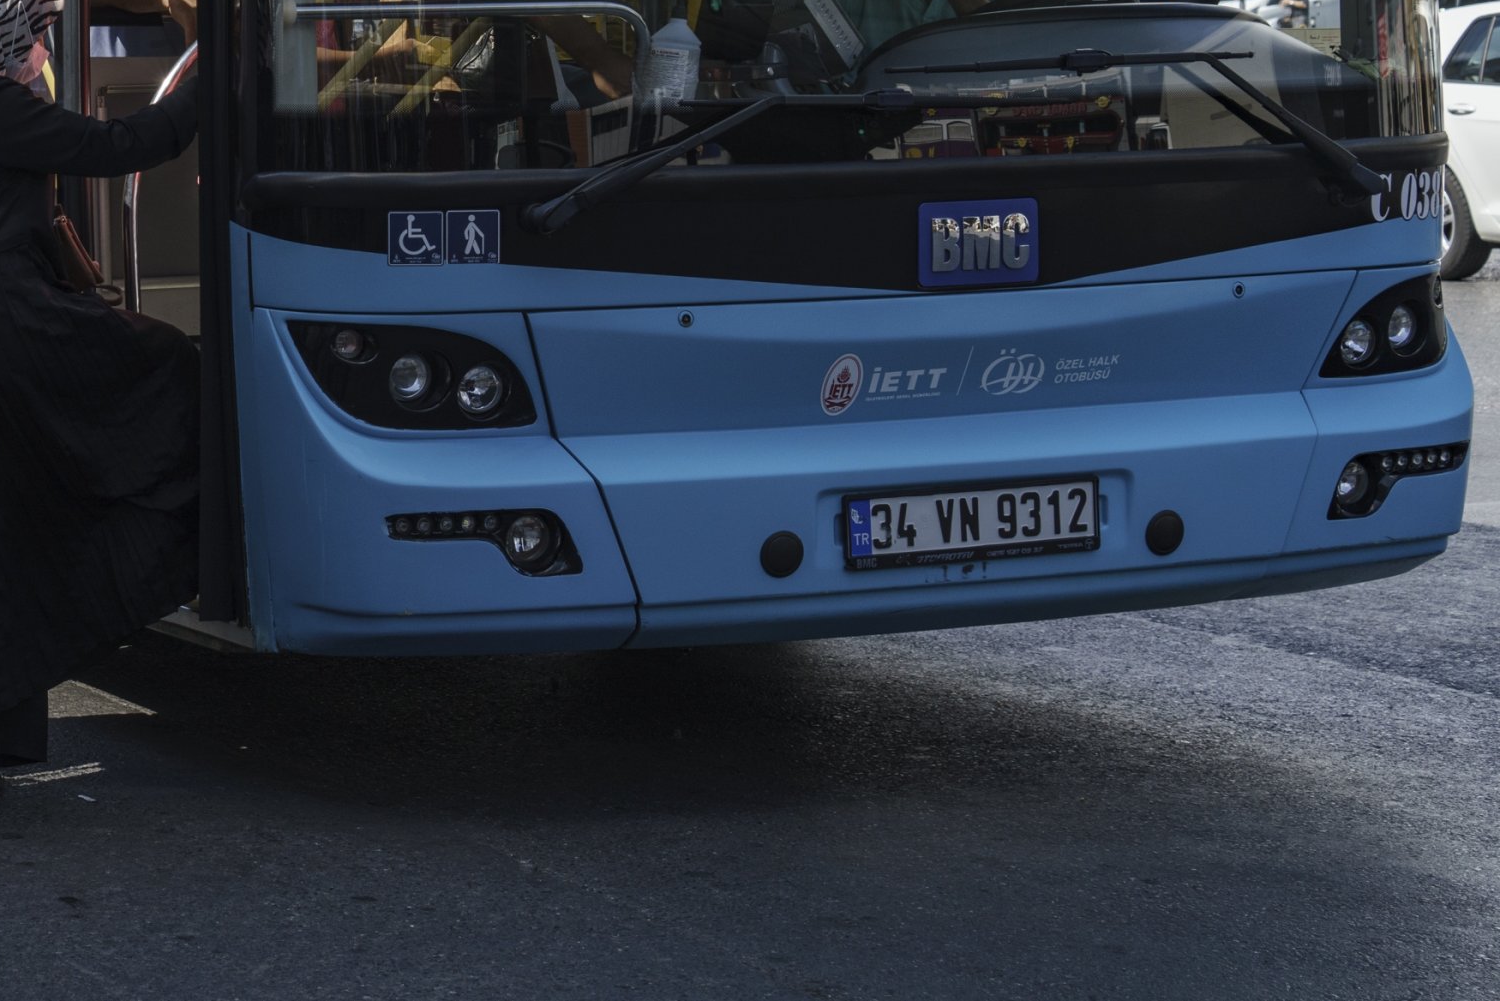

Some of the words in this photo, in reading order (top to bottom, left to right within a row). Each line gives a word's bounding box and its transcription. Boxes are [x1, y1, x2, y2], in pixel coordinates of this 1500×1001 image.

[931, 213, 1031, 272] BMC
[1055, 357, 1085, 370] ÖZEL
[1088, 354, 1120, 367] HALK
[868, 367, 948, 393] İETT
[1053, 367, 1112, 384] OTOBÜSÜ
[871, 502, 917, 549] 34
[936, 496, 980, 543] VN
[997, 487, 1088, 539] 9312
[852, 532, 870, 546] TR
